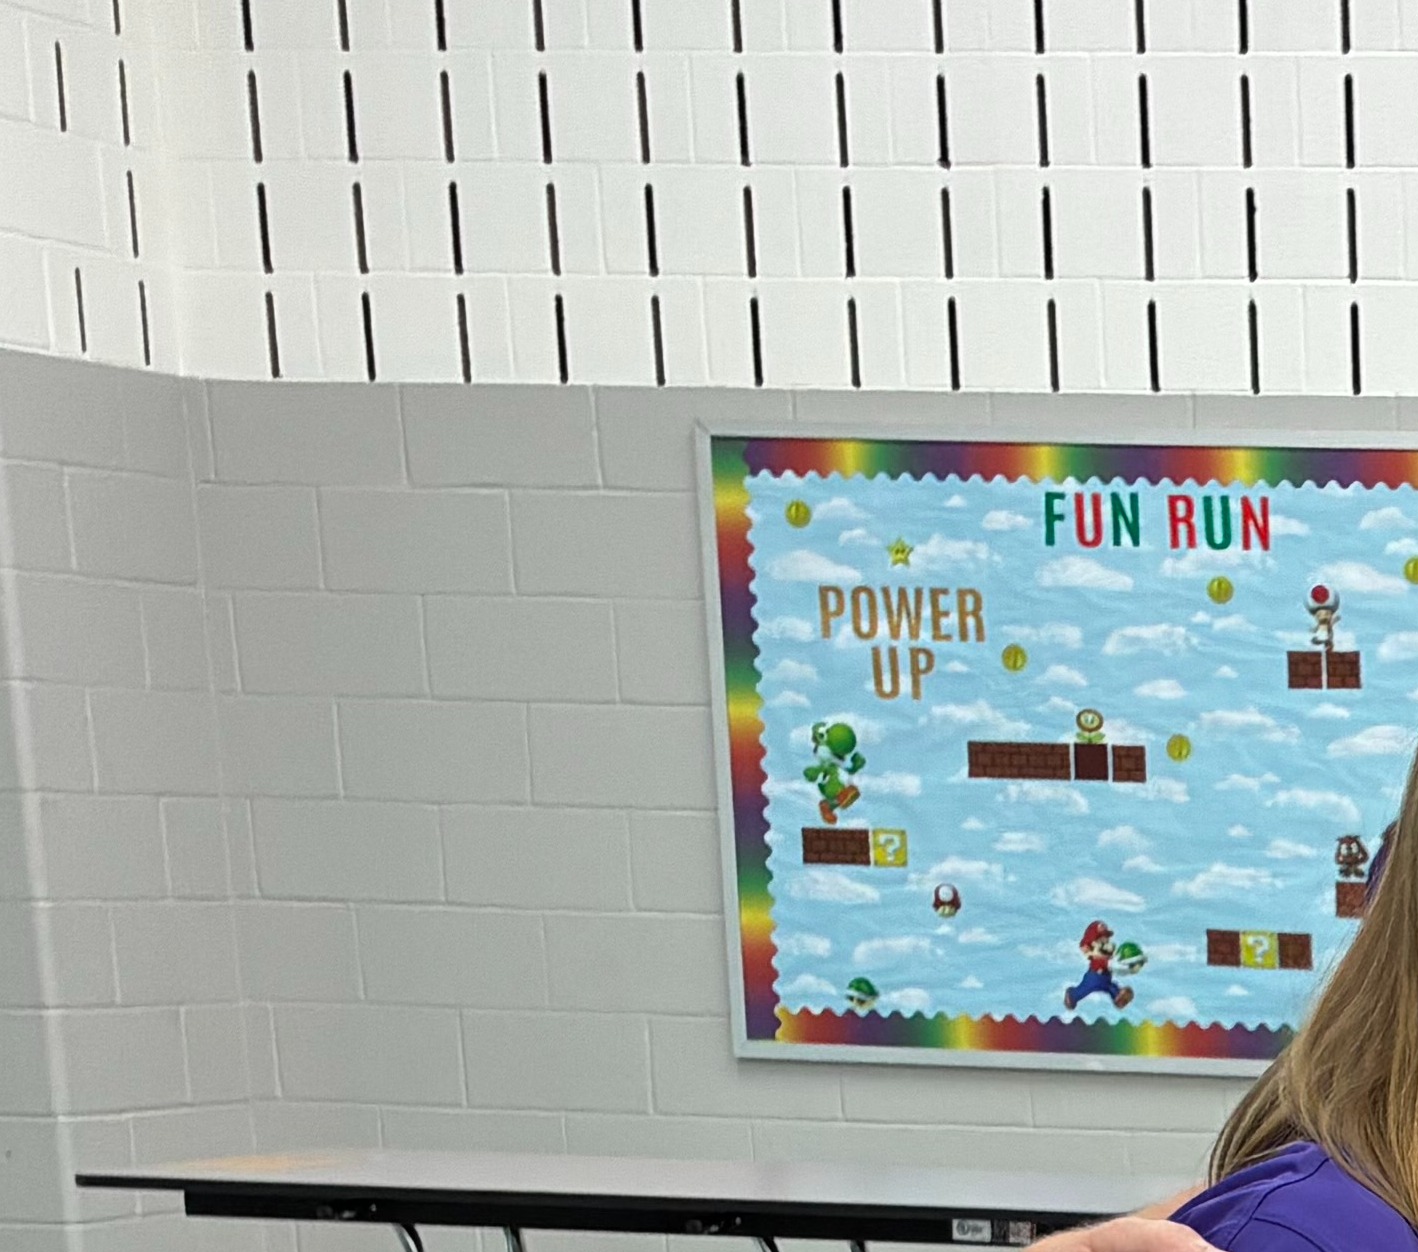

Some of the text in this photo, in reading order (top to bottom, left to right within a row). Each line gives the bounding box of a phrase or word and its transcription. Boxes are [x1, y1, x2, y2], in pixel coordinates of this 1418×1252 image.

[1044, 491, 1270, 551] FUN RUN
[818, 585, 985, 642] POWER
[871, 646, 936, 701] UP
